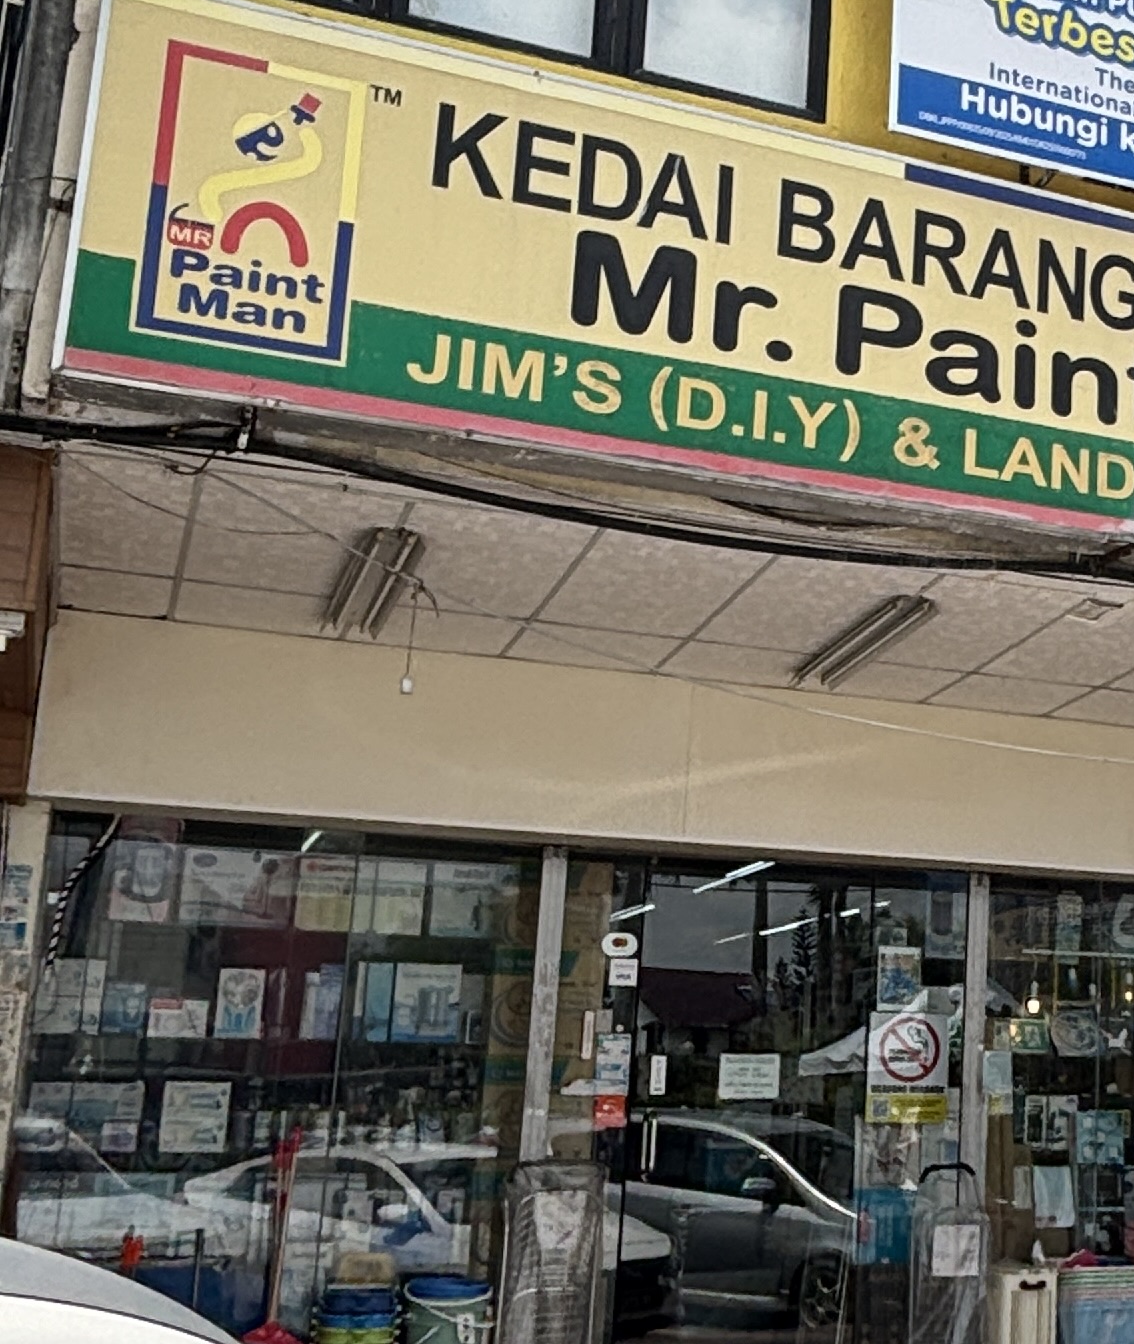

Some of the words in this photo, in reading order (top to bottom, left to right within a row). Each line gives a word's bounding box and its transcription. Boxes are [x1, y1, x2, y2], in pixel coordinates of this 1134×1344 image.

[370, 83, 402, 108] TM
[959, 82, 1110, 148] Hubungi
[430, 101, 736, 246] KEDAI
[170, 222, 213, 248] MR
[169, 248, 326, 306] Paint
[569, 229, 793, 363] Mr.
[176, 283, 307, 335] Man
[648, 364, 864, 463] (D.I.Y)
[892, 416, 941, 472] &
